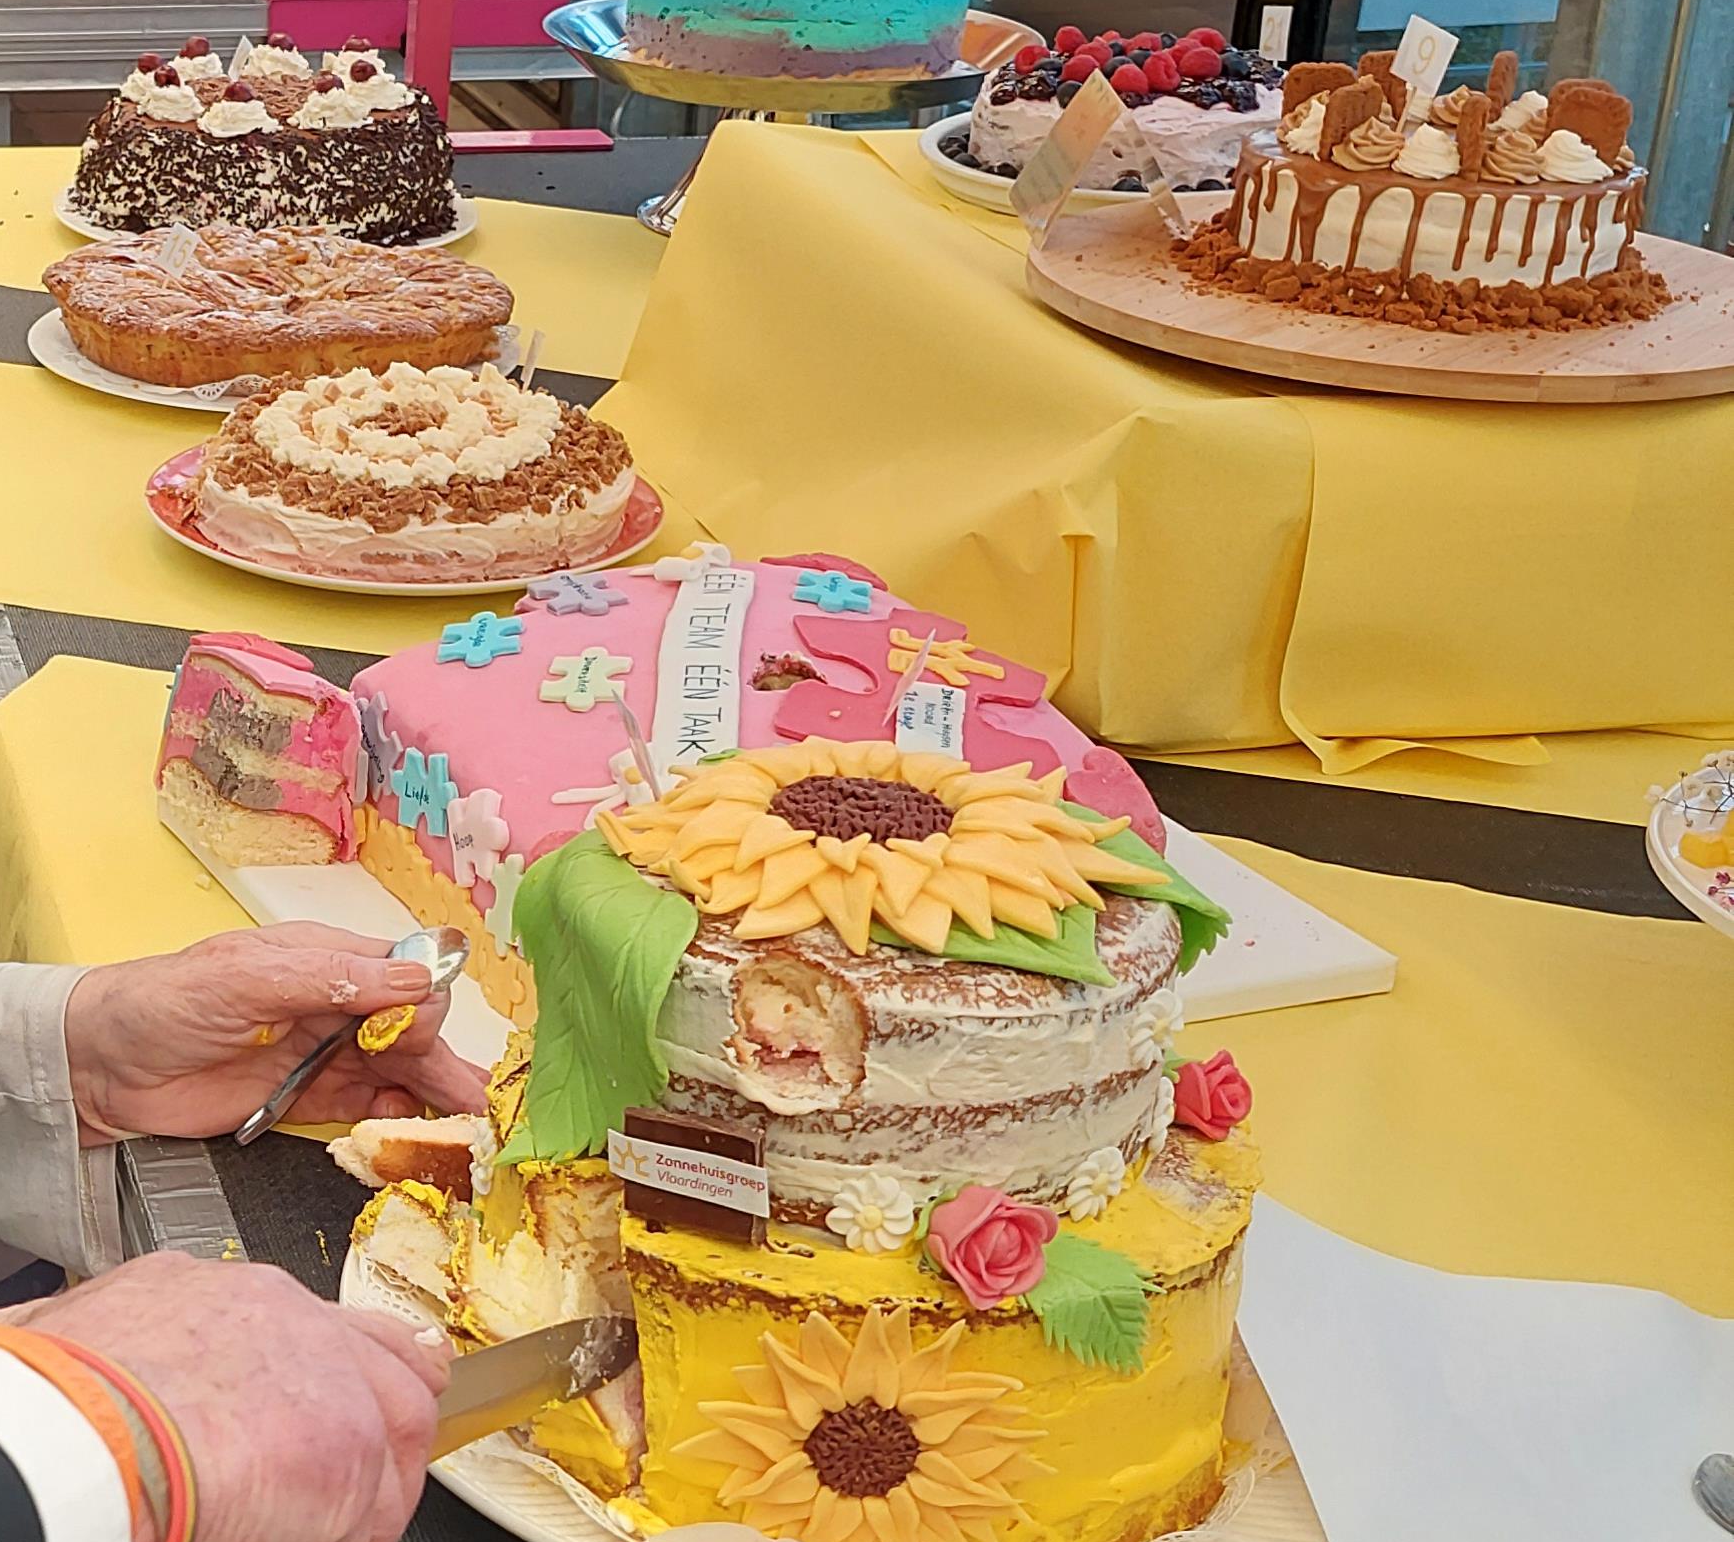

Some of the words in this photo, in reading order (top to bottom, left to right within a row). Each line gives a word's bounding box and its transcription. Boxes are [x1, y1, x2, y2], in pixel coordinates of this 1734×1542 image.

[167, 234, 192, 268] 15
[703, 573, 747, 594] ÉÉN
[684, 603, 731, 648] TEAM
[683, 664, 732, 699] ÉÉN
[676, 707, 722, 757] TAAK
[656, 1153, 765, 1193] Zonnehuisgroep
[657, 1170, 733, 1198] Vlaardingen
